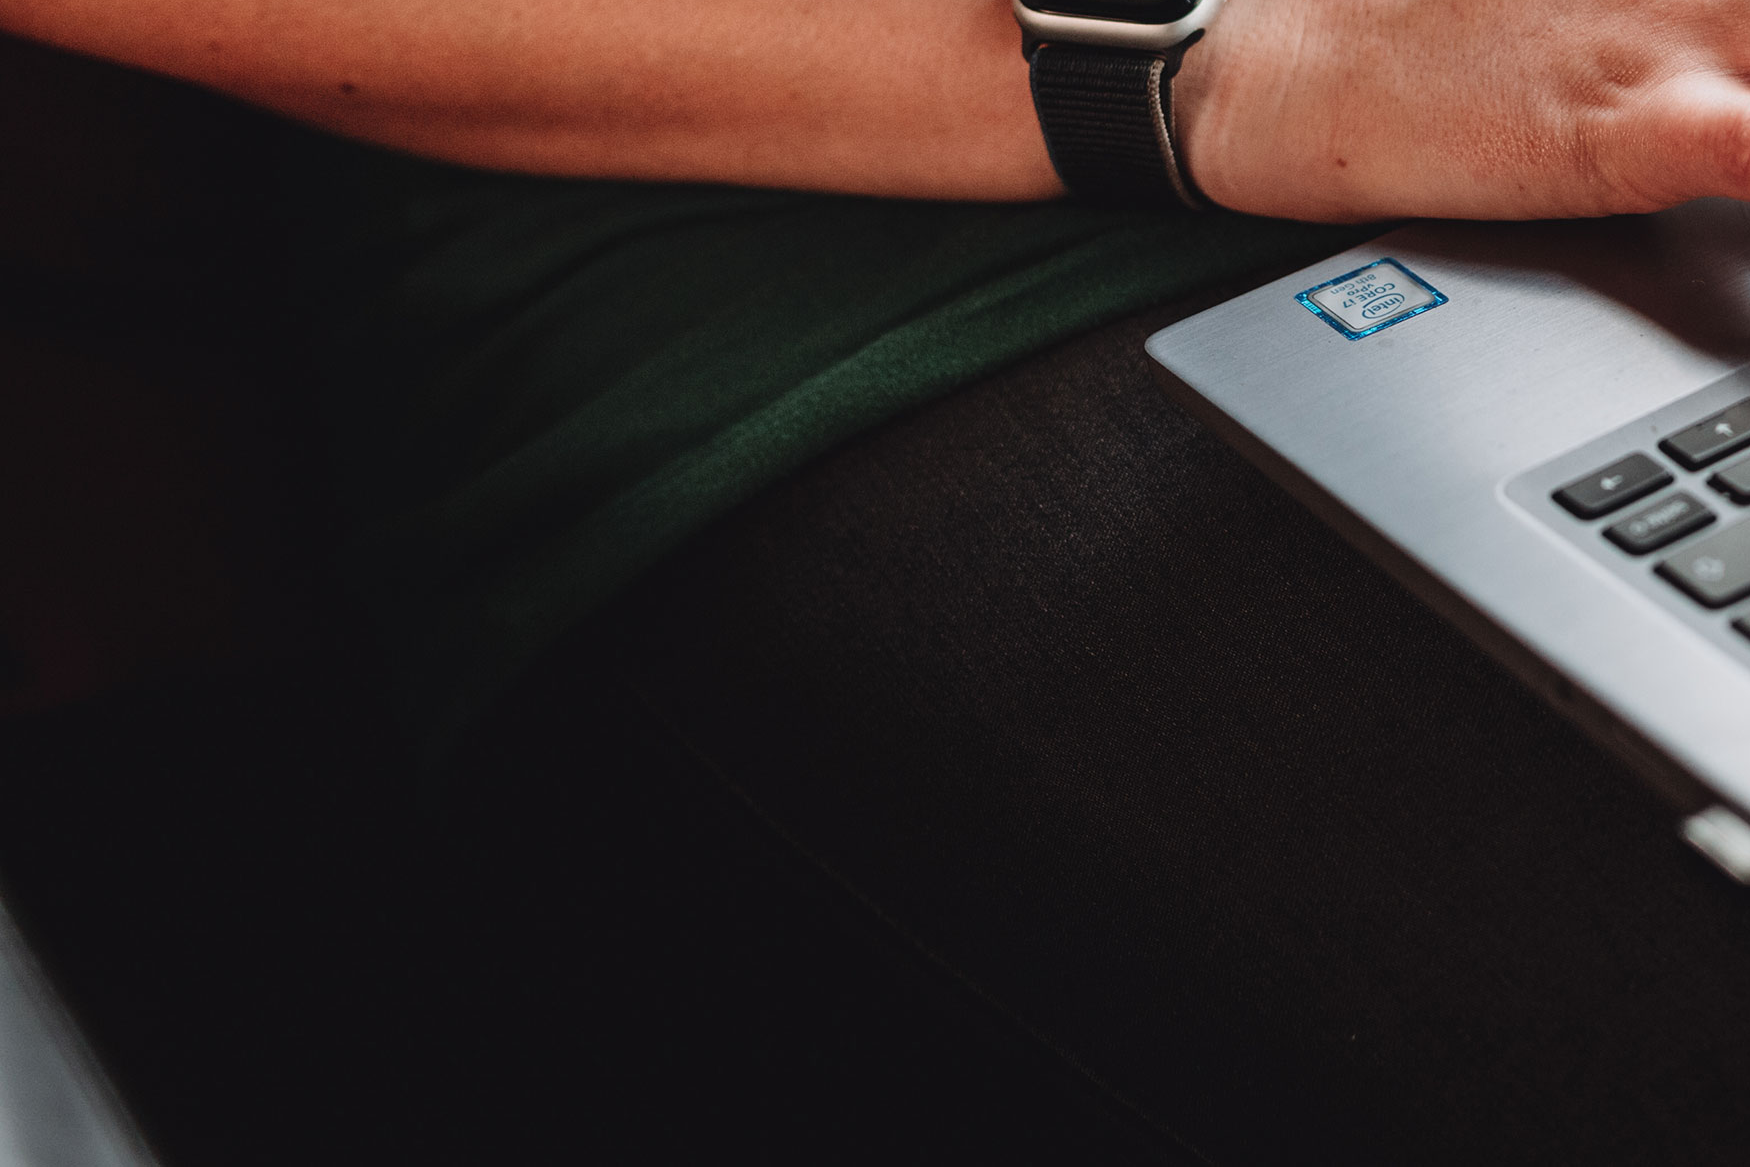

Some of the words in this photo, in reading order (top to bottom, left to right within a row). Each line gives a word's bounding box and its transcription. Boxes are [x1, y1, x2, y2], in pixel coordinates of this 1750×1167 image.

[1355, 274, 1376, 284] 8th
[1330, 283, 1355, 294] Gen
[1347, 283, 1374, 296] vPro
[1356, 283, 1395, 302] CORE
[1343, 298, 1357, 308] i7
[1366, 297, 1401, 315] intel
